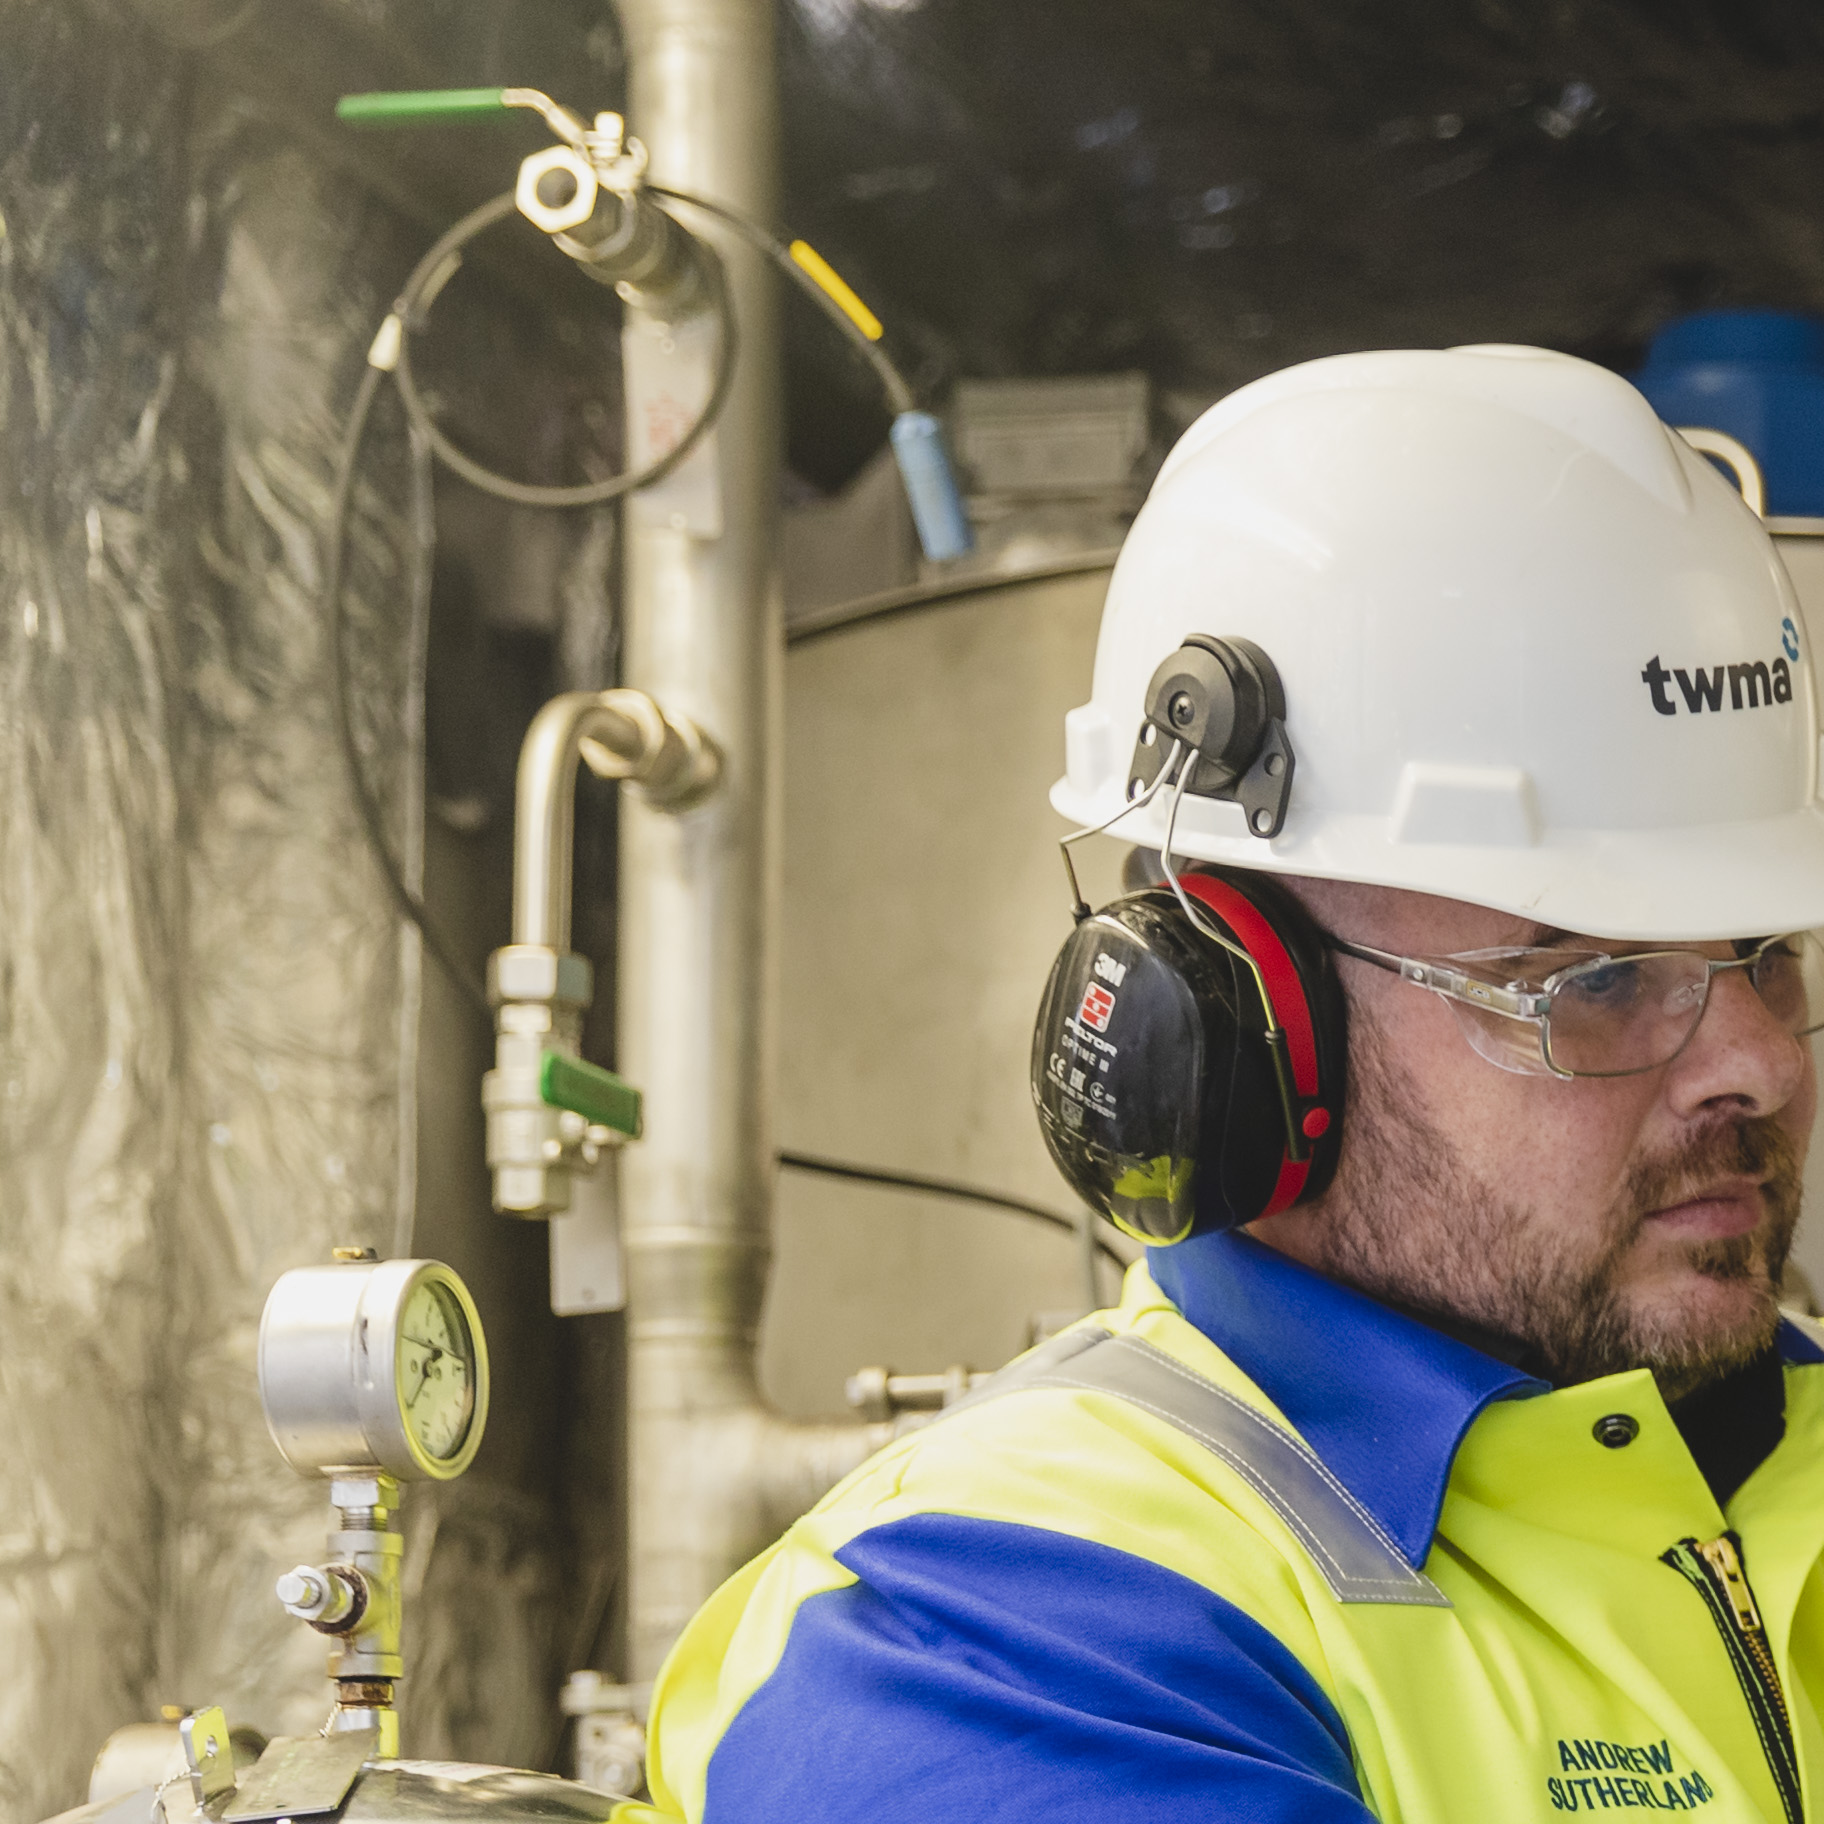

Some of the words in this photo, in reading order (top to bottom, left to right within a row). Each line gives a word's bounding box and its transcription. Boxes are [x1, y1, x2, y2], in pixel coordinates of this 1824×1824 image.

[1641, 655, 1793, 716] twma
[1094, 953, 1127, 988] 3M
[1064, 1016, 1118, 1058] PELTOR
[1558, 1739, 1674, 1775] ANDREW
